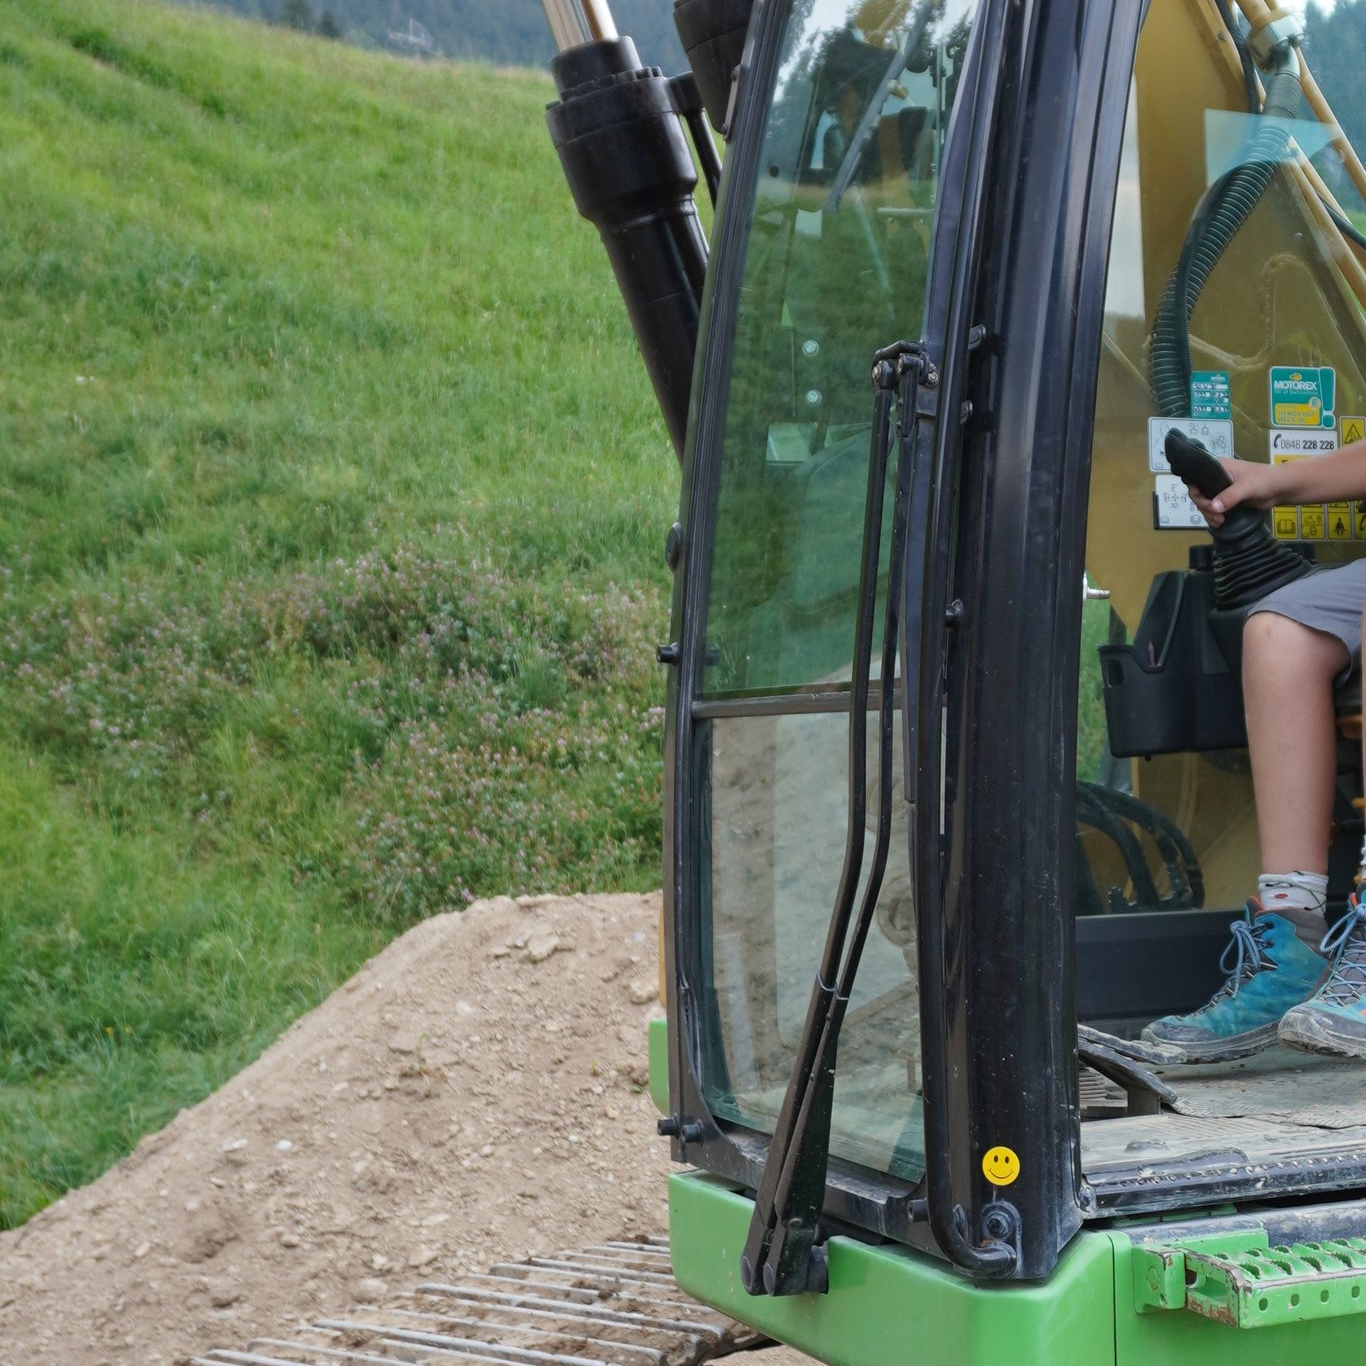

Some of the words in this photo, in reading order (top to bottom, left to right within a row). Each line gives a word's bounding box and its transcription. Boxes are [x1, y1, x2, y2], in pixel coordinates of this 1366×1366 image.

[1274, 380, 1317, 390] MOTOREX
[1281, 439, 1300, 449] 0848
[1303, 440, 1318, 449] 228
[1320, 440, 1335, 450] 228
